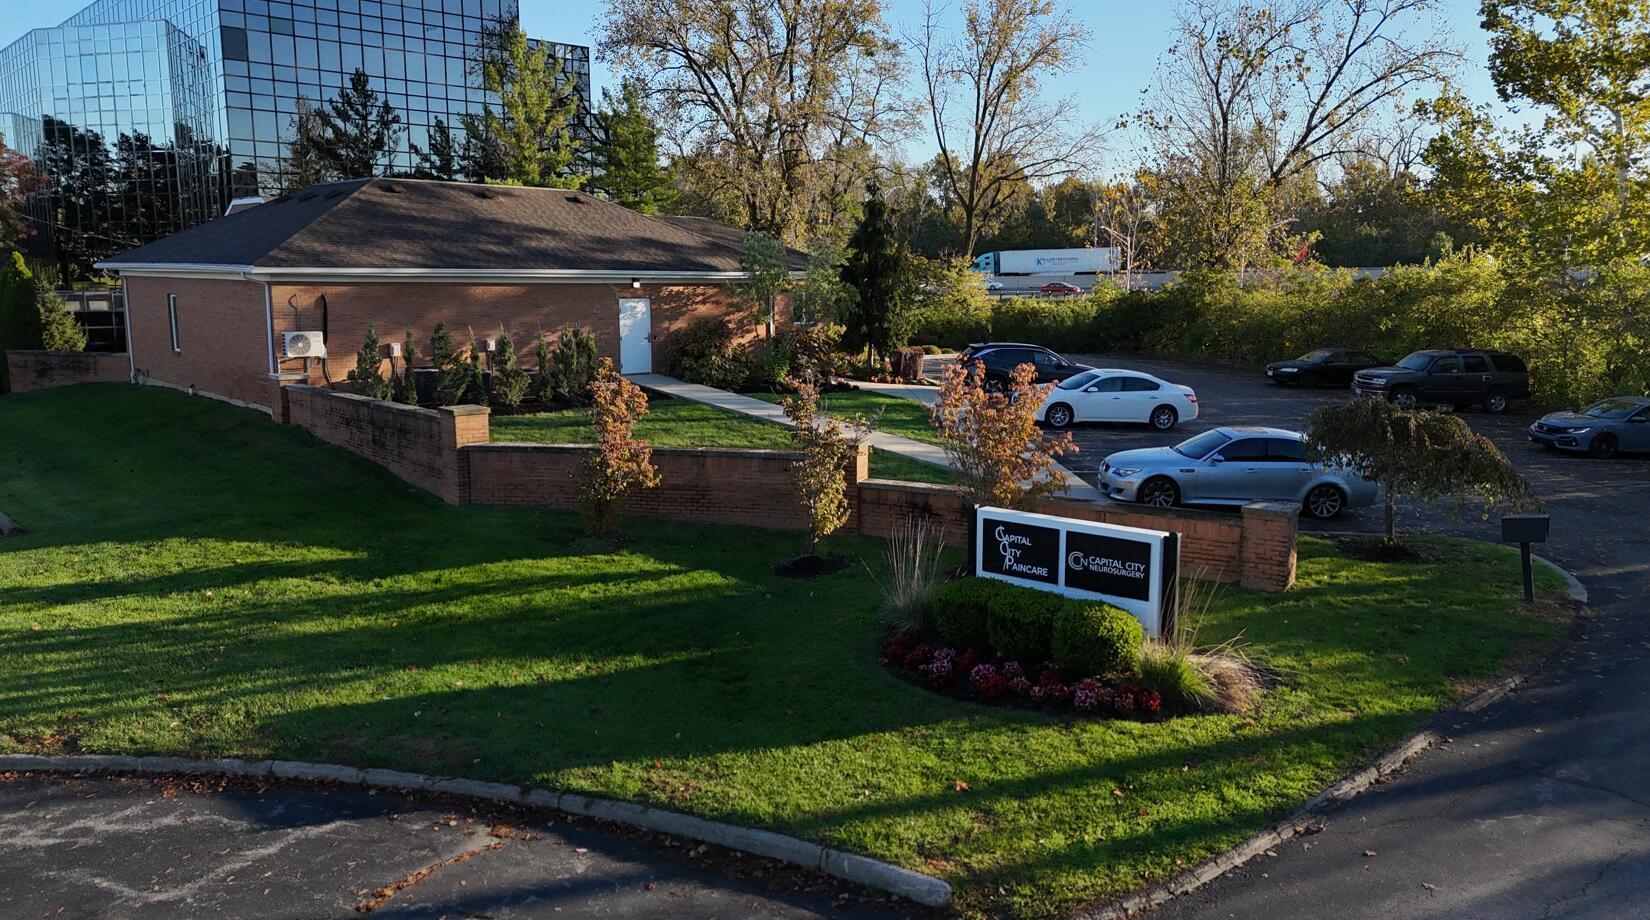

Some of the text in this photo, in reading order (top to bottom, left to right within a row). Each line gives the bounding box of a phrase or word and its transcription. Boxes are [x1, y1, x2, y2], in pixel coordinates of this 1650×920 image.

[995, 525, 1032, 546] CAPITAL
[1000, 543, 1021, 558] CITY
[1003, 555, 1048, 577] PAINCARE
[1089, 556, 1146, 572] CAPITAL CITY
[1089, 564, 1145, 579] NEUROSURGERY
